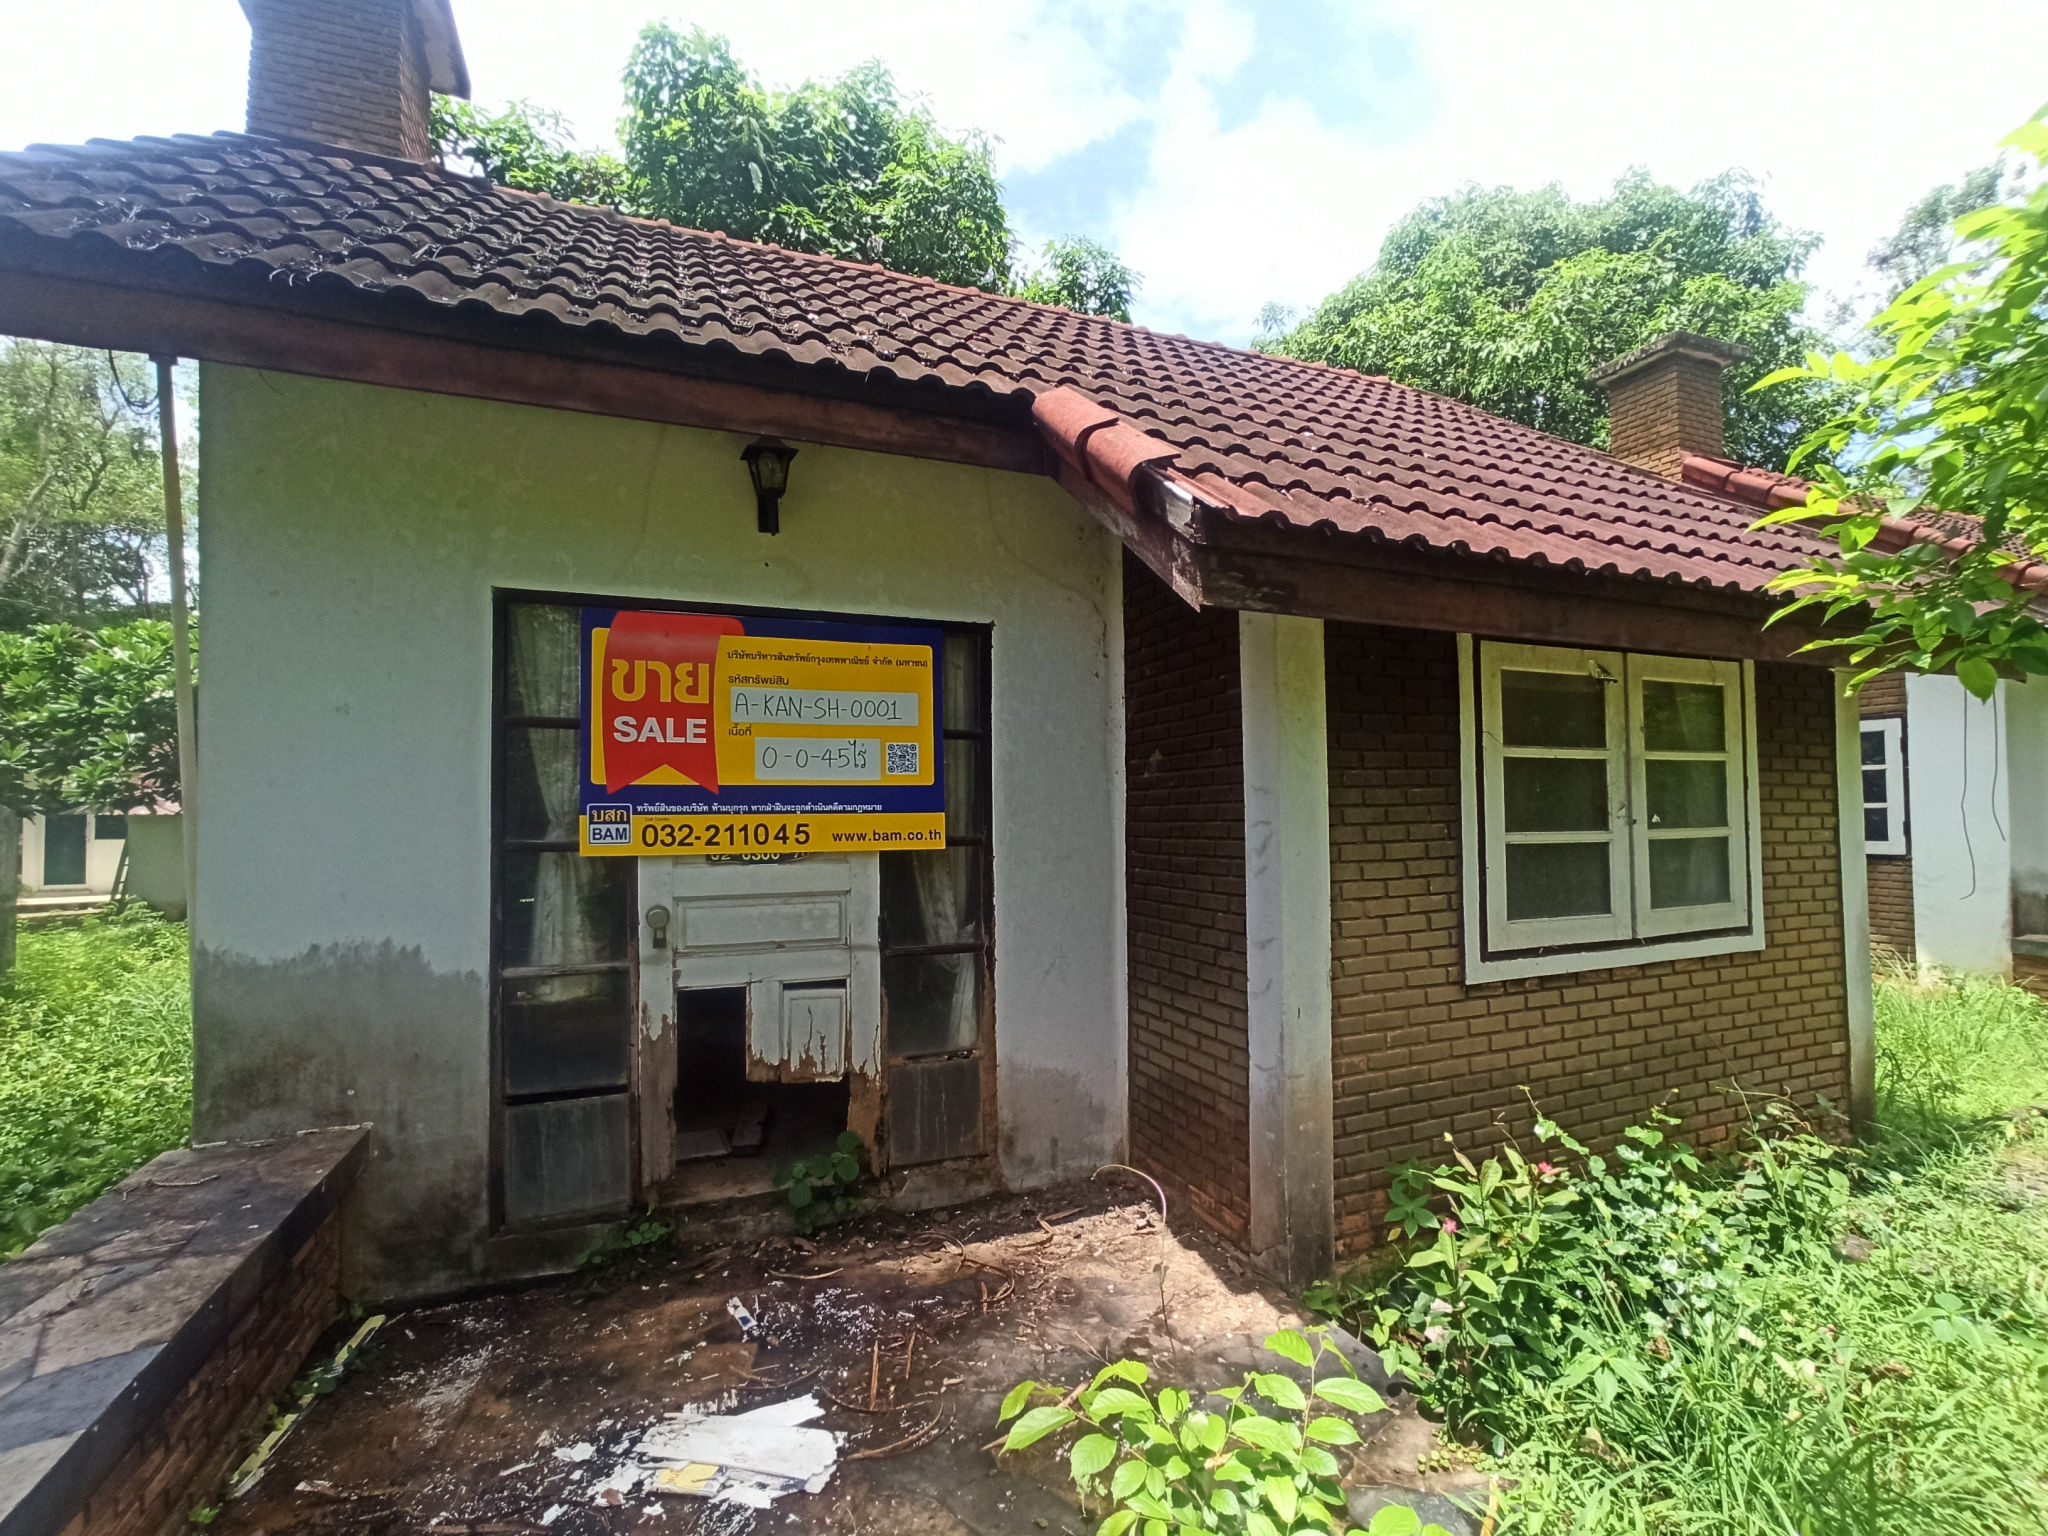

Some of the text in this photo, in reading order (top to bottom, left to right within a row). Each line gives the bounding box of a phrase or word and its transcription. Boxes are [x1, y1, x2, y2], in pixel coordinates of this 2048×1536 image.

[872, 655, 893, 667] จำกัด
[895, 656, 929, 668] (มหาชน)
[612, 658, 710, 704] ขาย
[727, 673, 790, 686] รหัสทรัพย์สิน
[734, 692, 903, 720] A-KAN-SH-0001
[613, 715, 707, 744] SALE
[728, 723, 753, 737] เนื้อที่
[591, 807, 628, 822] บสก
[635, 801, 709, 812] ทรัพย์สินของบริษัท
[711, 802, 748, 814] ห้ามบุกรุก
[592, 827, 628, 841] BAM
[641, 822, 811, 848] 032-211045
[831, 828, 942, 842] www.bam.co.th
